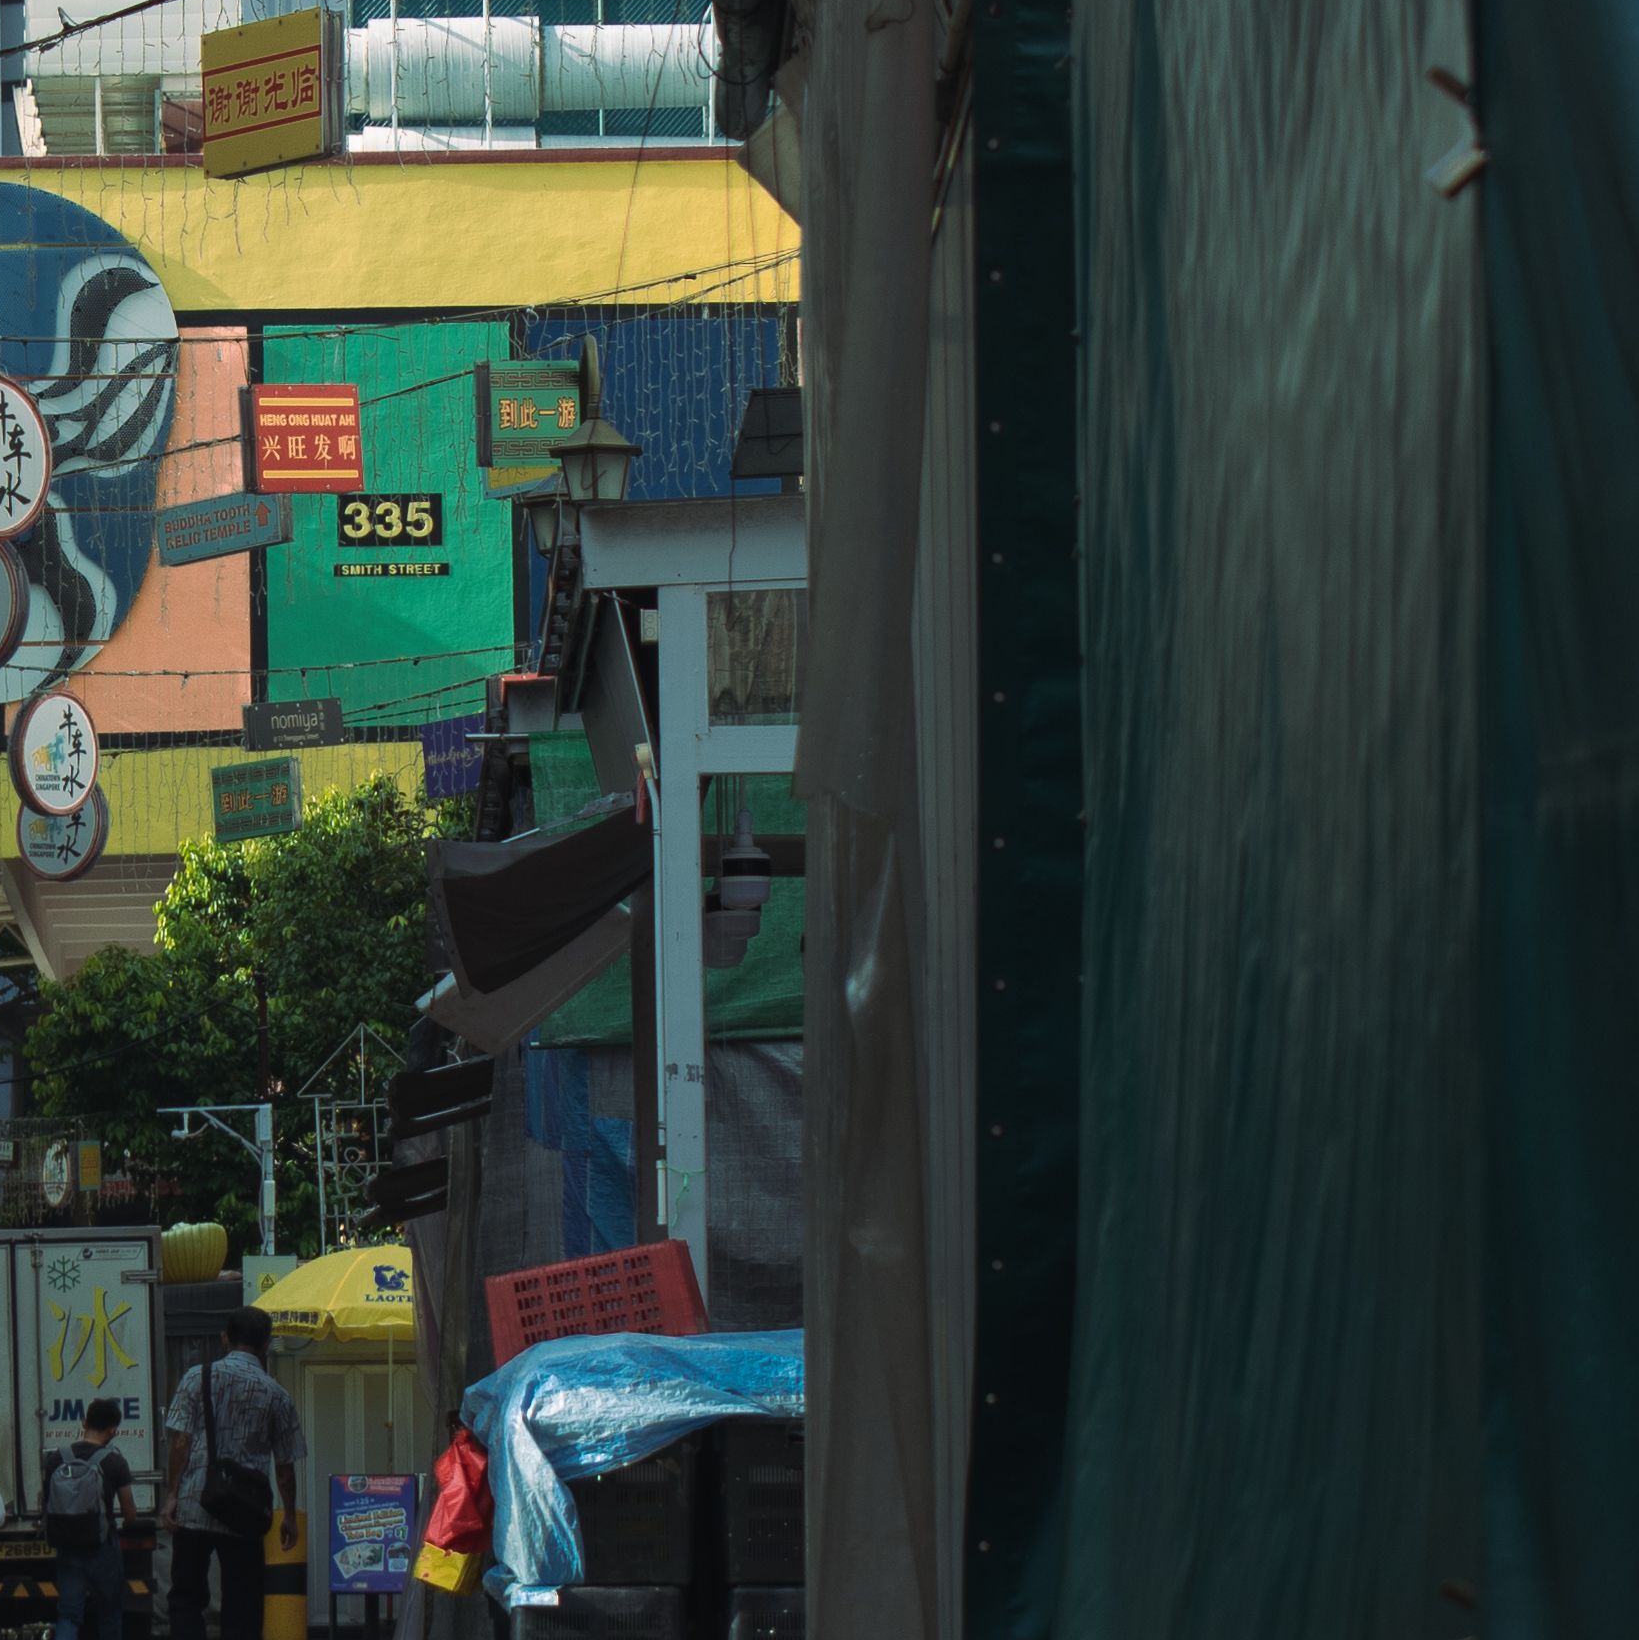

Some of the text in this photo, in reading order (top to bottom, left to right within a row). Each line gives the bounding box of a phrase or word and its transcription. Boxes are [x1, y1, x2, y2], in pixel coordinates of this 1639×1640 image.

[209, 64, 316, 126] 谢谢光临
[260, 414, 287, 426] HENG
[288, 414, 309, 426] ONG
[311, 414, 337, 426] HUAT
[499, 398, 576, 430] 到此一游
[262, 434, 356, 461] 兴旺发啊
[164, 503, 250, 534] BUDDHA TOOTH
[343, 502, 434, 538] 335
[166, 520, 251, 551] RELIC TEMPLE
[341, 564, 441, 575] SMITH STREET
[271, 709, 318, 731] nomiya
[59, 704, 87, 798] 牛车水
[220, 783, 288, 814] 到此一游
[47, 1286, 139, 1388] 冰
[49, 1398, 85, 1422] JM
